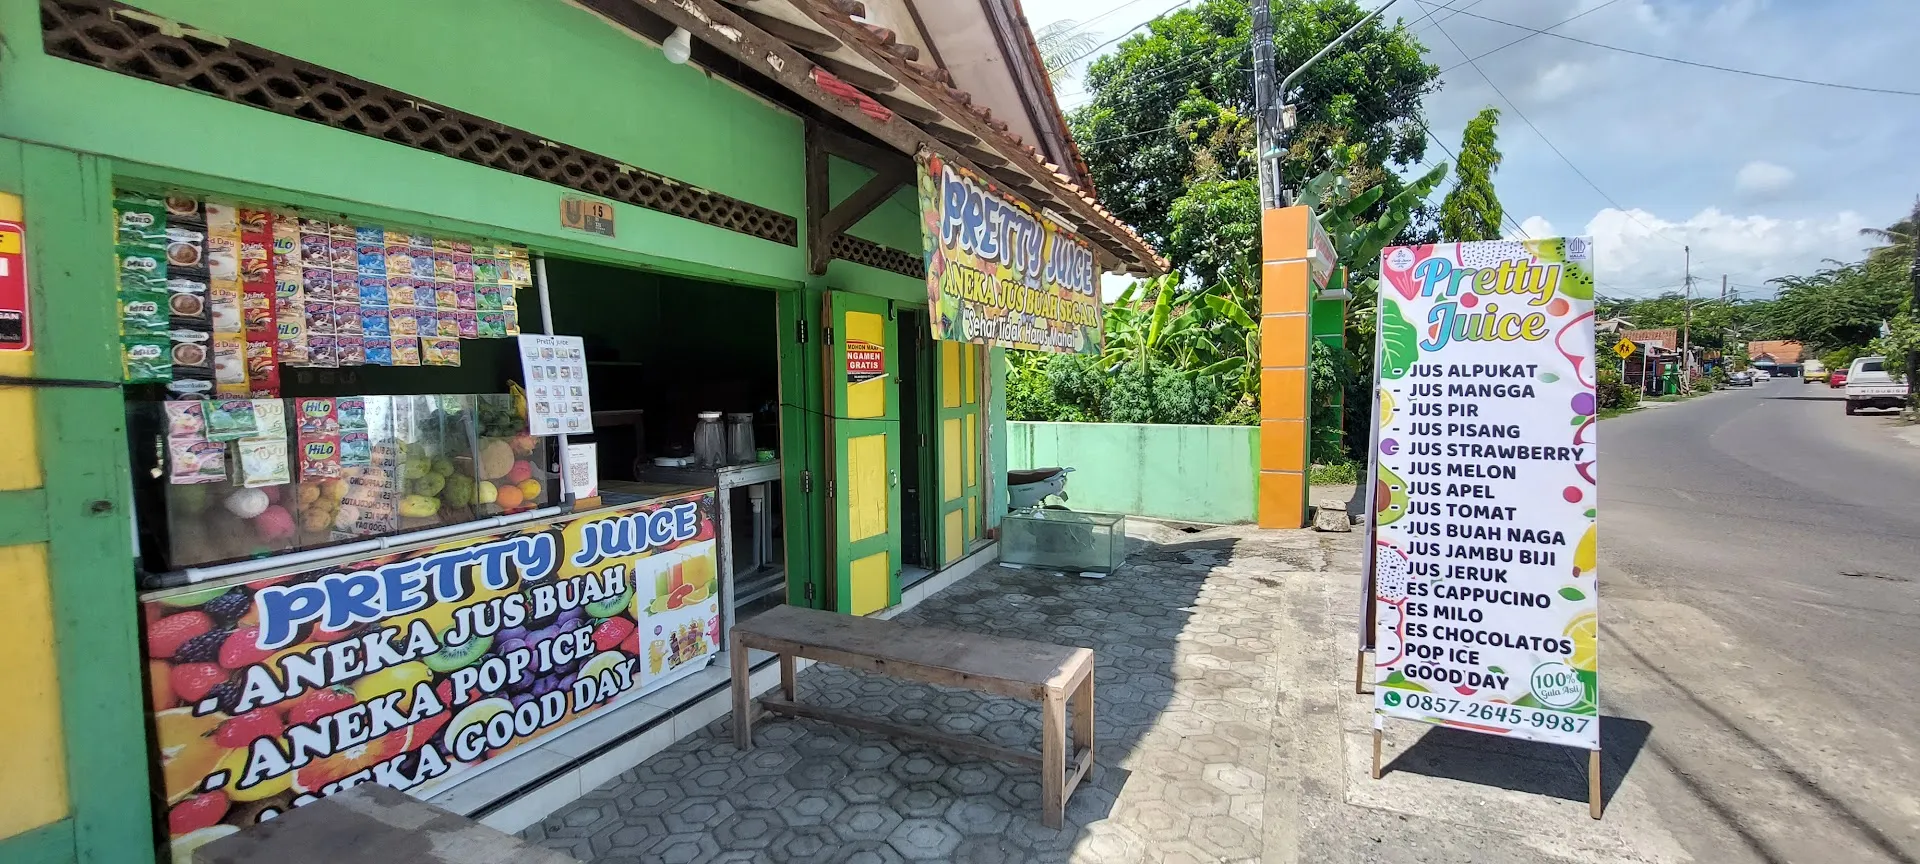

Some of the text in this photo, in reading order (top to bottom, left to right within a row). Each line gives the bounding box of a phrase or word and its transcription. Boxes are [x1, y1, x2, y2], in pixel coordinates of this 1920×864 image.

[593, 205, 603, 217] 15
[940, 165, 1093, 295] PRETTY JUICE
[272, 240, 293, 249] iLo
[1415, 257, 1560, 306] Pretty
[945, 260, 1097, 328] ANEKA JUS BUAH SEGAR
[998, 316, 1022, 343] Tidak
[1024, 321, 1049, 346] Harus
[1419, 303, 1550, 352] Juice
[847, 352, 880, 360] NGAMEN
[850, 361, 878, 369] GRATIS
[1410, 365, 1442, 377] JUS
[1448, 365, 1537, 377] ALPUKAT
[1410, 384, 1442, 396] JUS
[1448, 384, 1534, 398] MANGGA
[306, 402, 330, 413] HiLo
[1410, 403, 1442, 416] JUS
[1448, 404, 1478, 416] PIR
[1409, 423, 1442, 436] JUS
[1448, 424, 1519, 438] PISANG
[308, 444, 334, 455] HiLo
[1409, 442, 1441, 455] JUS
[1447, 444, 1583, 461] STRAWBERRY
[1408, 462, 1441, 475] JUS
[1447, 464, 1515, 479] MELON
[1408, 482, 1441, 495] JUS
[1447, 484, 1494, 498] APEL
[1408, 502, 1440, 515] JUS
[1446, 504, 1516, 520] TOMAT
[1407, 522, 1440, 536] JUS
[1447, 524, 1500, 540] BUAH
[1508, 528, 1565, 545] NAGA
[1407, 542, 1440, 556] JUS
[1446, 545, 1512, 562] JAMBU
[1520, 550, 1555, 566] BIJI
[256, 502, 698, 650] PRETTY JUICE
[1407, 562, 1439, 577] JUS
[1446, 565, 1507, 583] JERUK
[1407, 582, 1428, 596] ES
[1434, 585, 1550, 608] CAPPUCINO
[1406, 603, 1427, 617] ES
[1434, 605, 1482, 622] MILO
[233, 618, 440, 716] ANEKA
[449, 591, 524, 647] JUS
[528, 563, 627, 618] BUAH
[1406, 623, 1427, 637] ES
[1433, 626, 1572, 655] CHOCOLATOS
[1405, 643, 1443, 659] POP
[1450, 648, 1479, 665] ICE
[1404, 664, 1462, 683] GOOD
[1468, 672, 1509, 690] DAY
[1536, 672, 1575, 689] 100%
[1541, 685, 1579, 700] Gula Asli
[238, 684, 445, 791] ANEKA
[450, 645, 533, 706] POP
[535, 622, 597, 674] ICE
[453, 685, 569, 766] GOOD
[573, 656, 641, 720] DAY
[1406, 693, 1590, 734] 0857-2645-9987
